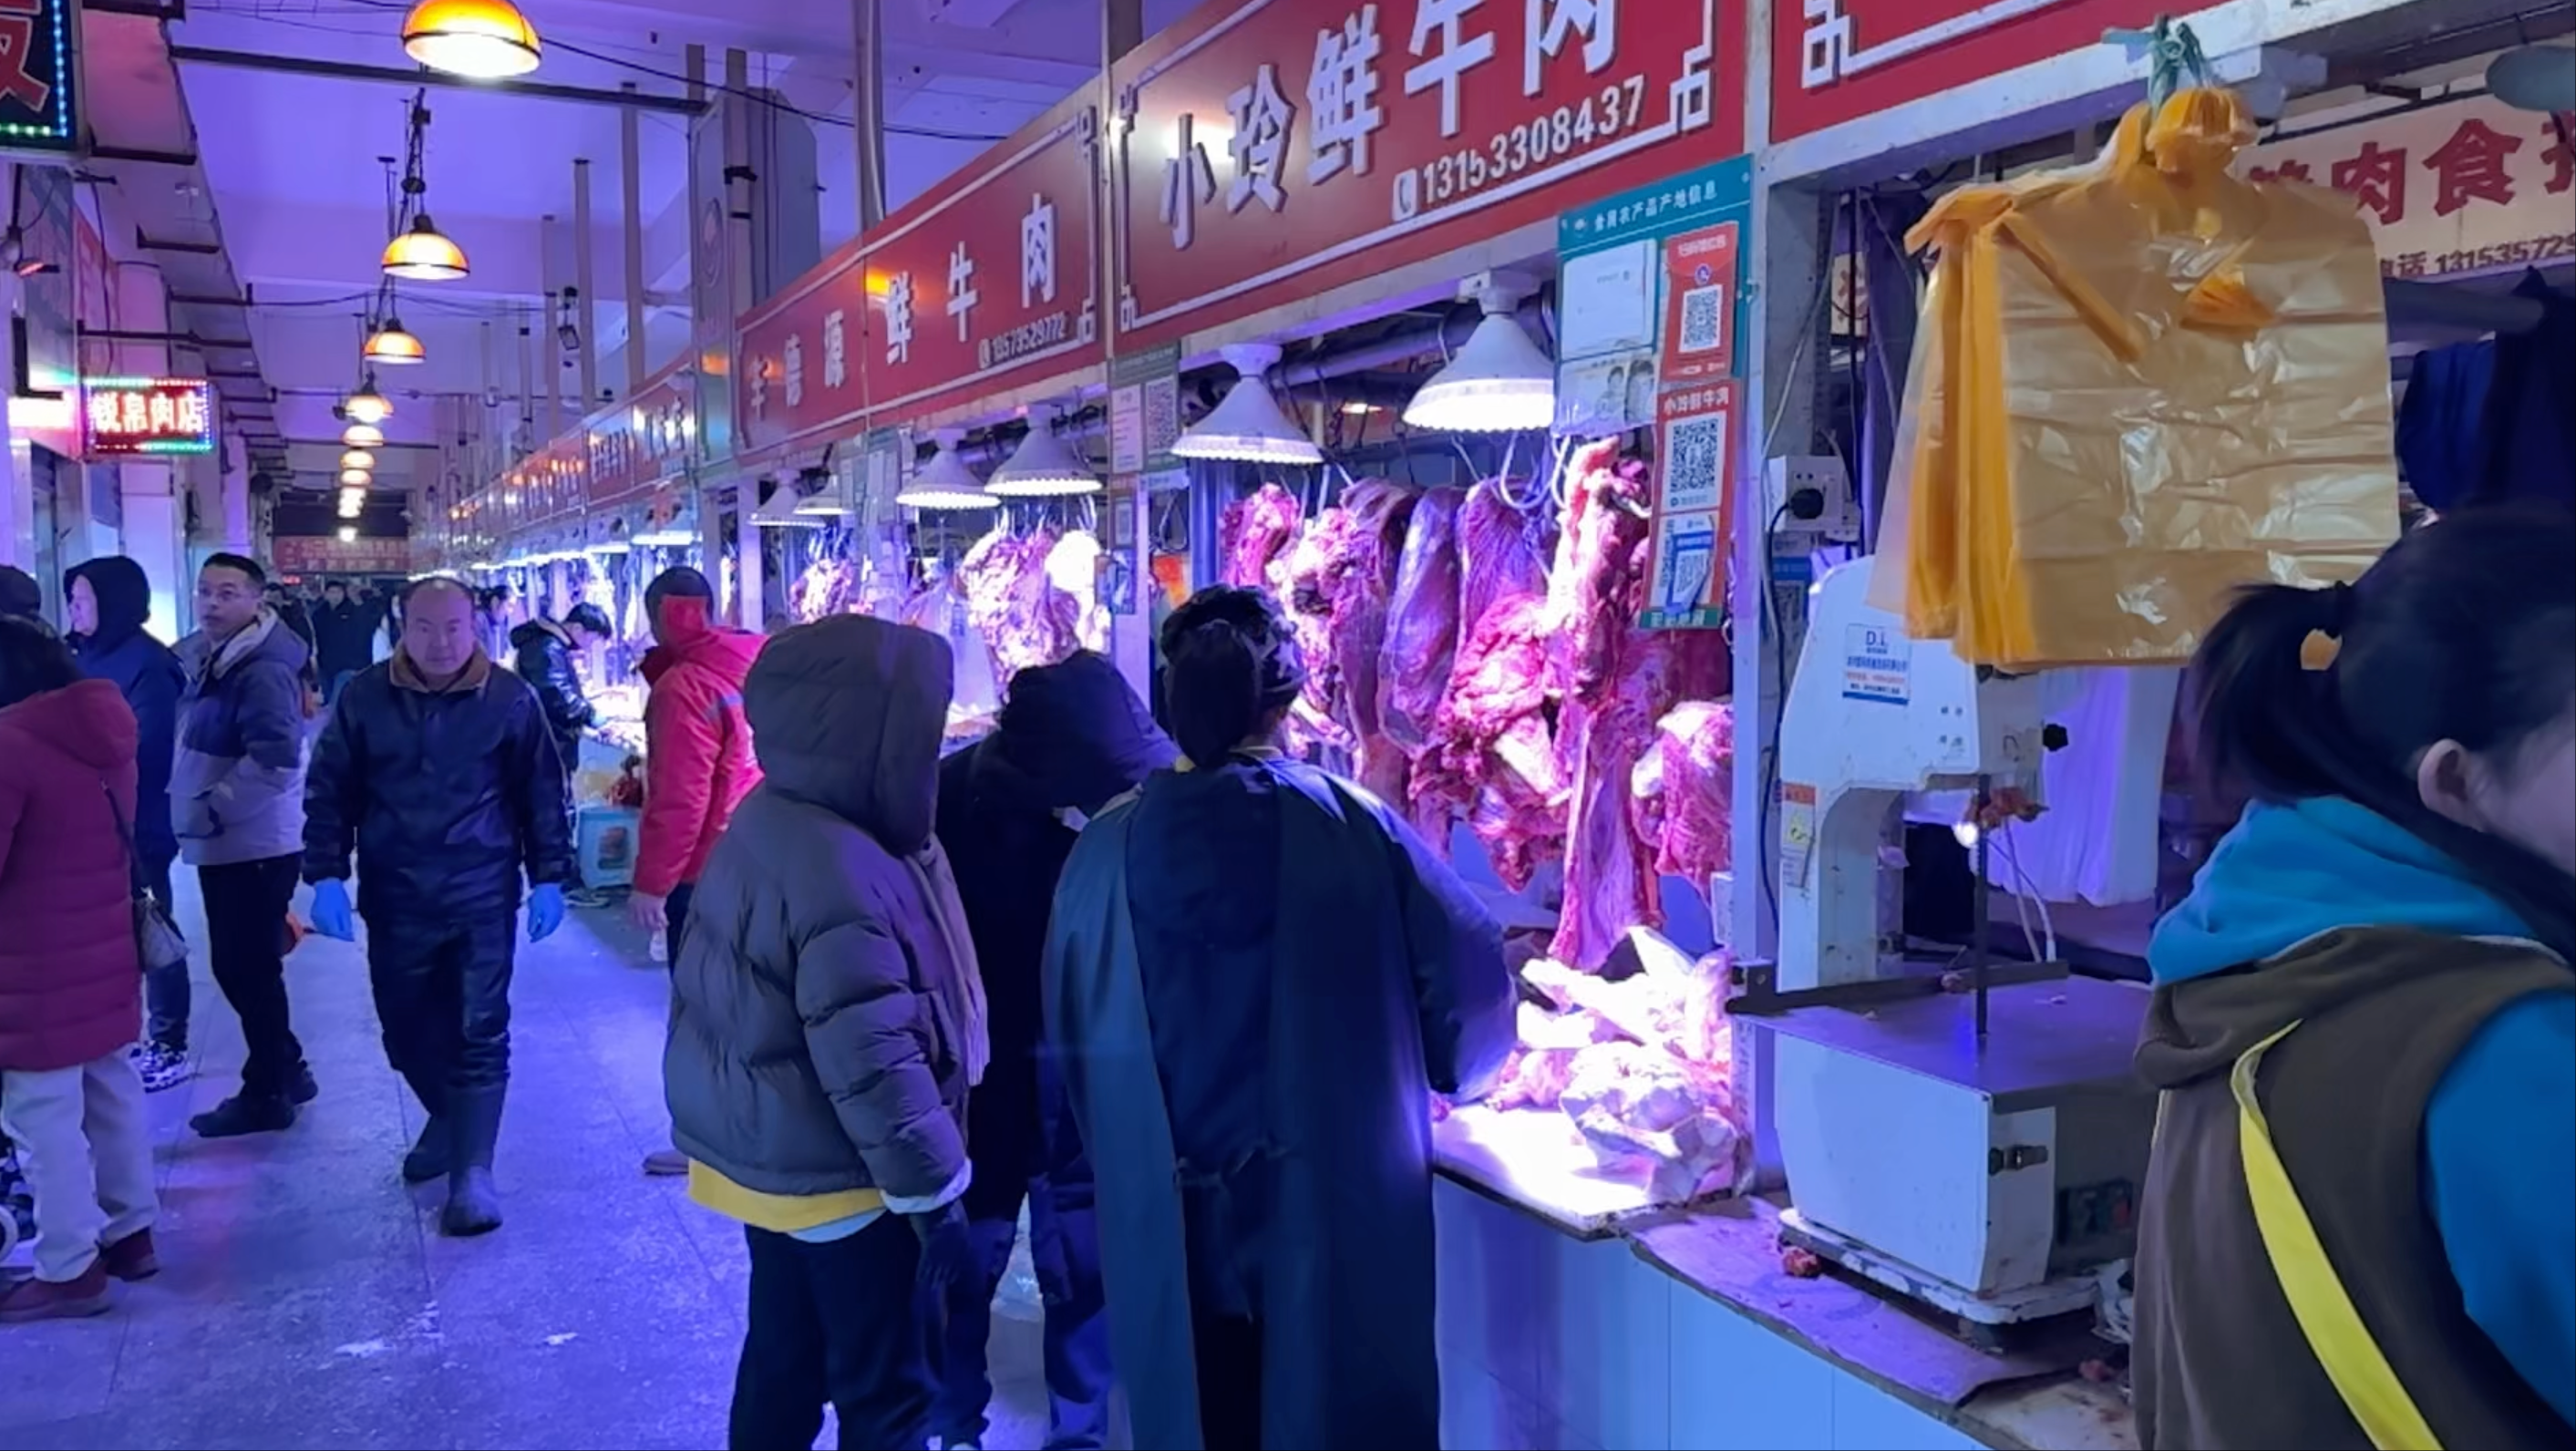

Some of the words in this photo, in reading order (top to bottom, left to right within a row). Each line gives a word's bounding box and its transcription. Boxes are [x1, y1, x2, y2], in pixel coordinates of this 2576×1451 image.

[1160, 0, 1614, 249] 小玲鲜牛肉
[1424, 74, 1644, 203] 13153308437
[2248, 117, 2575, 225] 肉食
